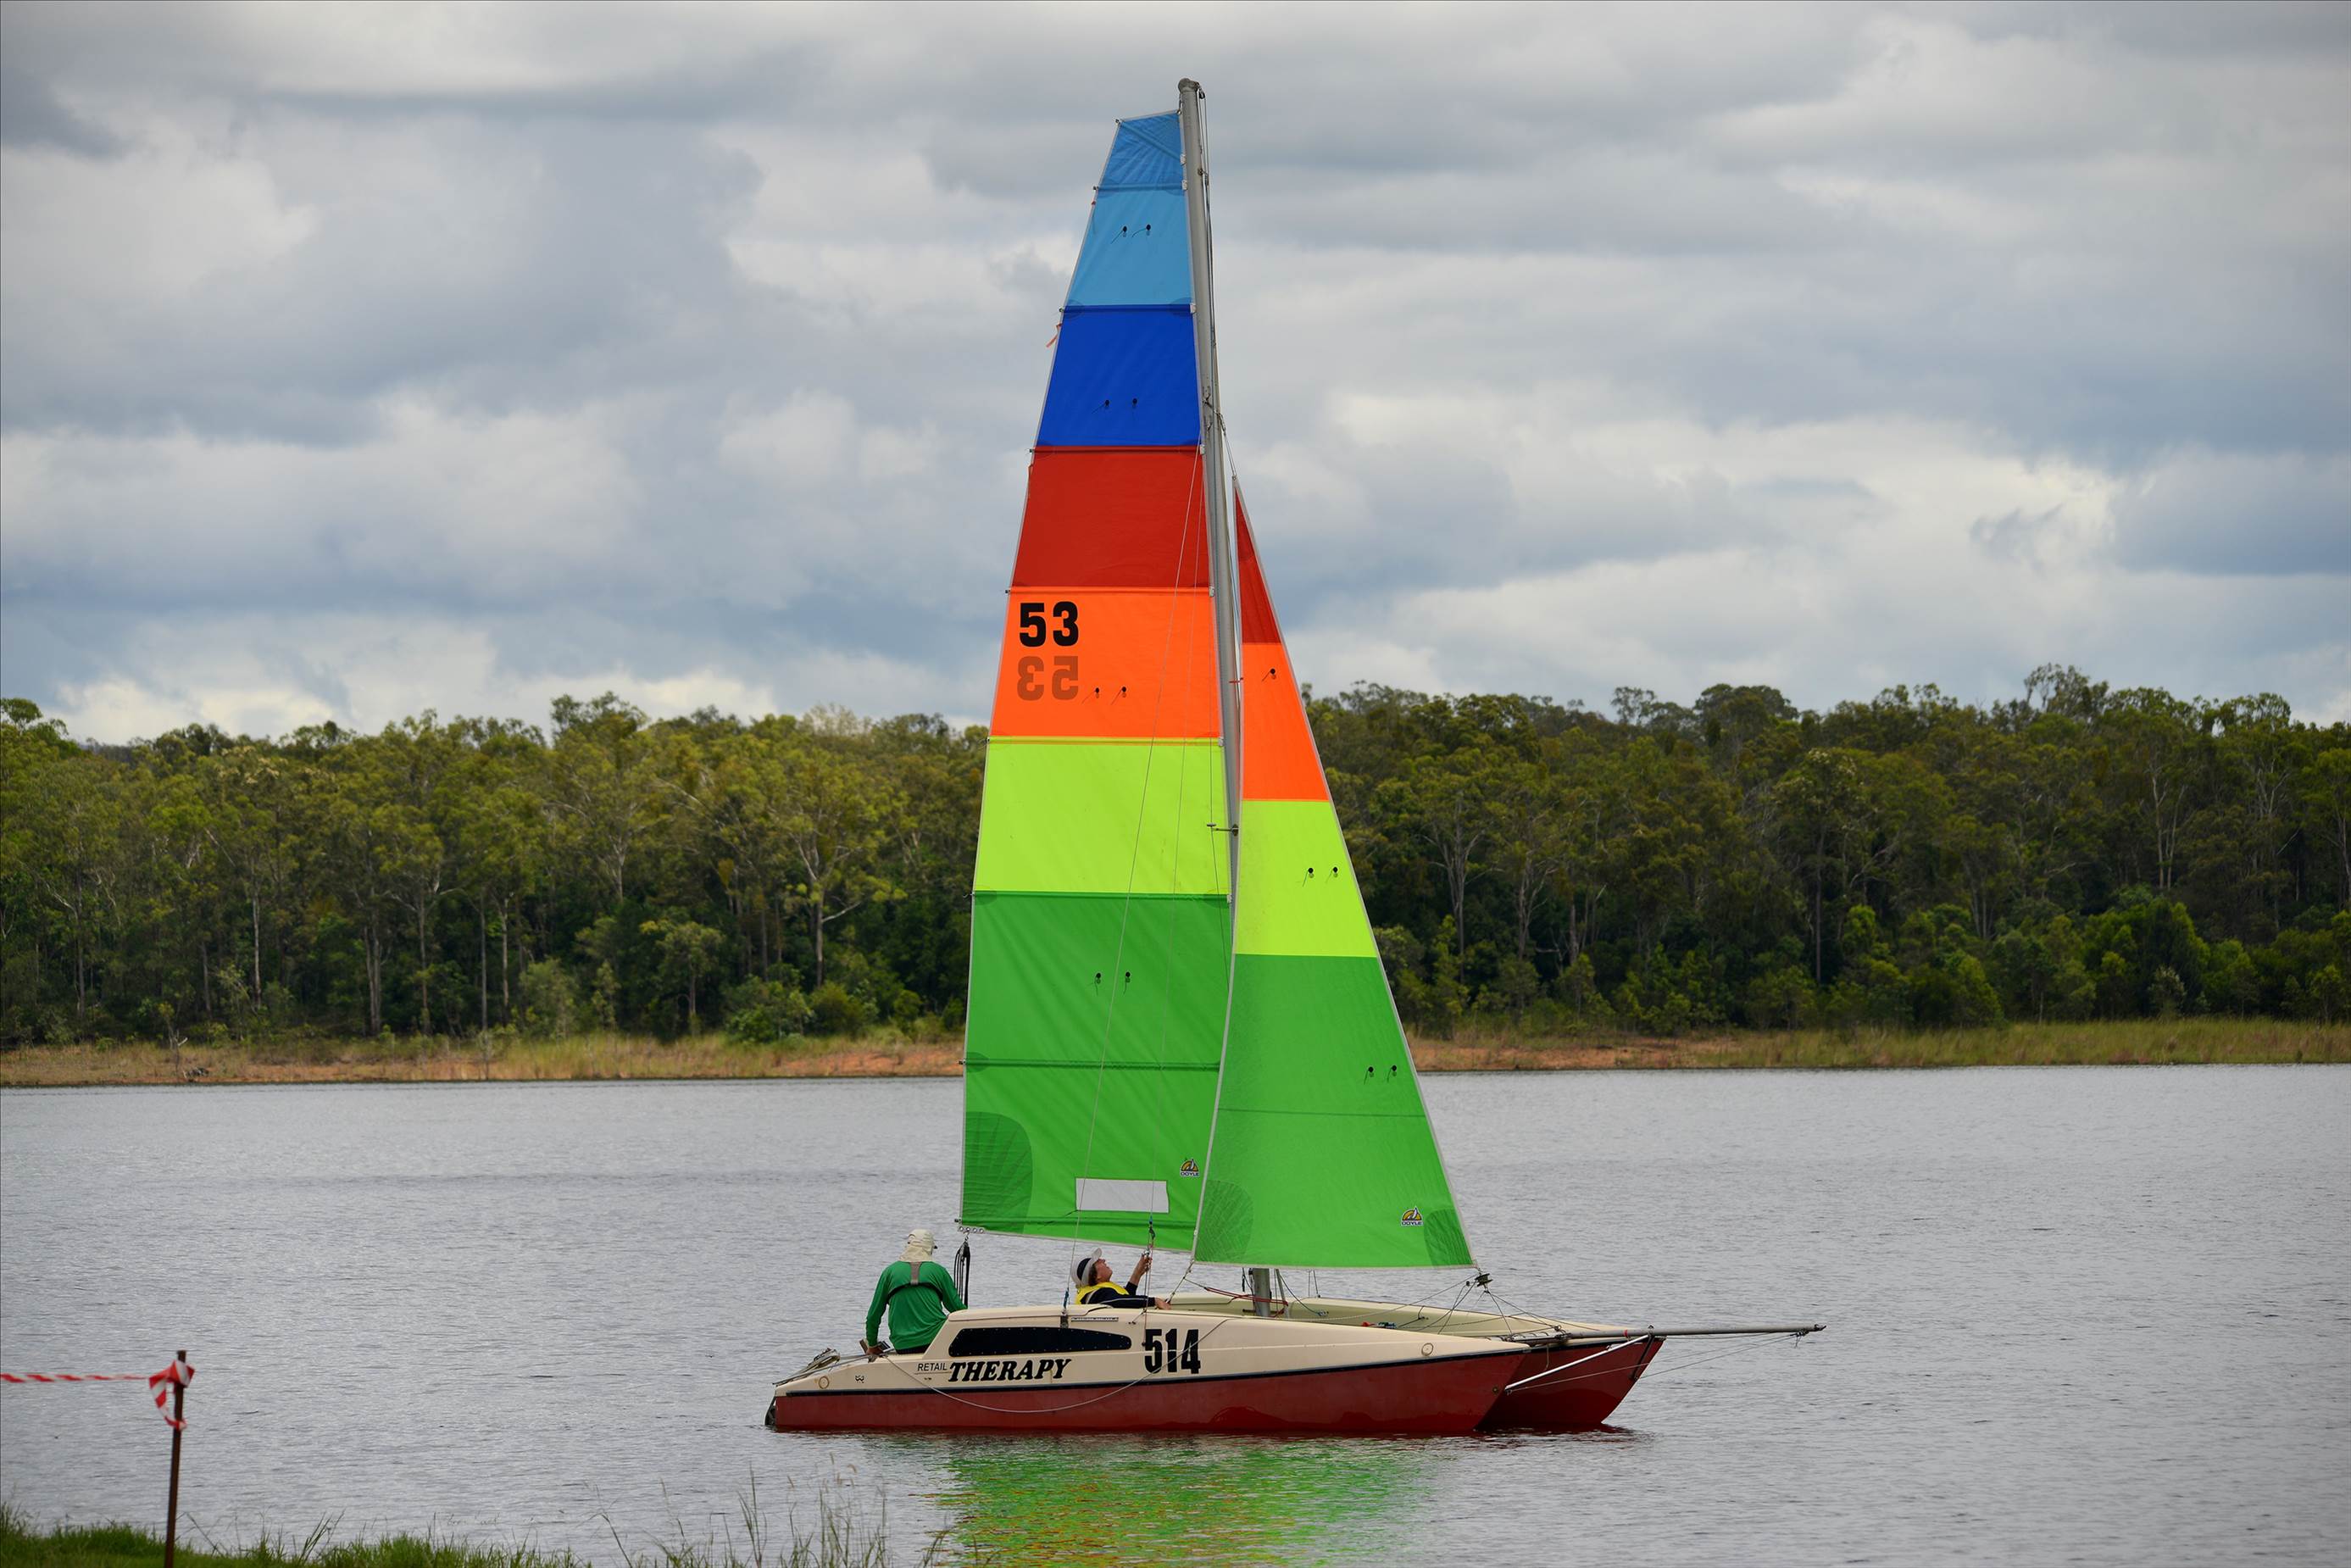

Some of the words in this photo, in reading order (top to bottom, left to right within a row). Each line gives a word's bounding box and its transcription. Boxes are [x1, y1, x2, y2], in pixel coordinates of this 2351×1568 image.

[1020, 601, 1079, 647] 53
[917, 1363, 948, 1371] RETAIL
[948, 1359, 1071, 1382] THERAPY
[1145, 1329, 1201, 1374] 514
